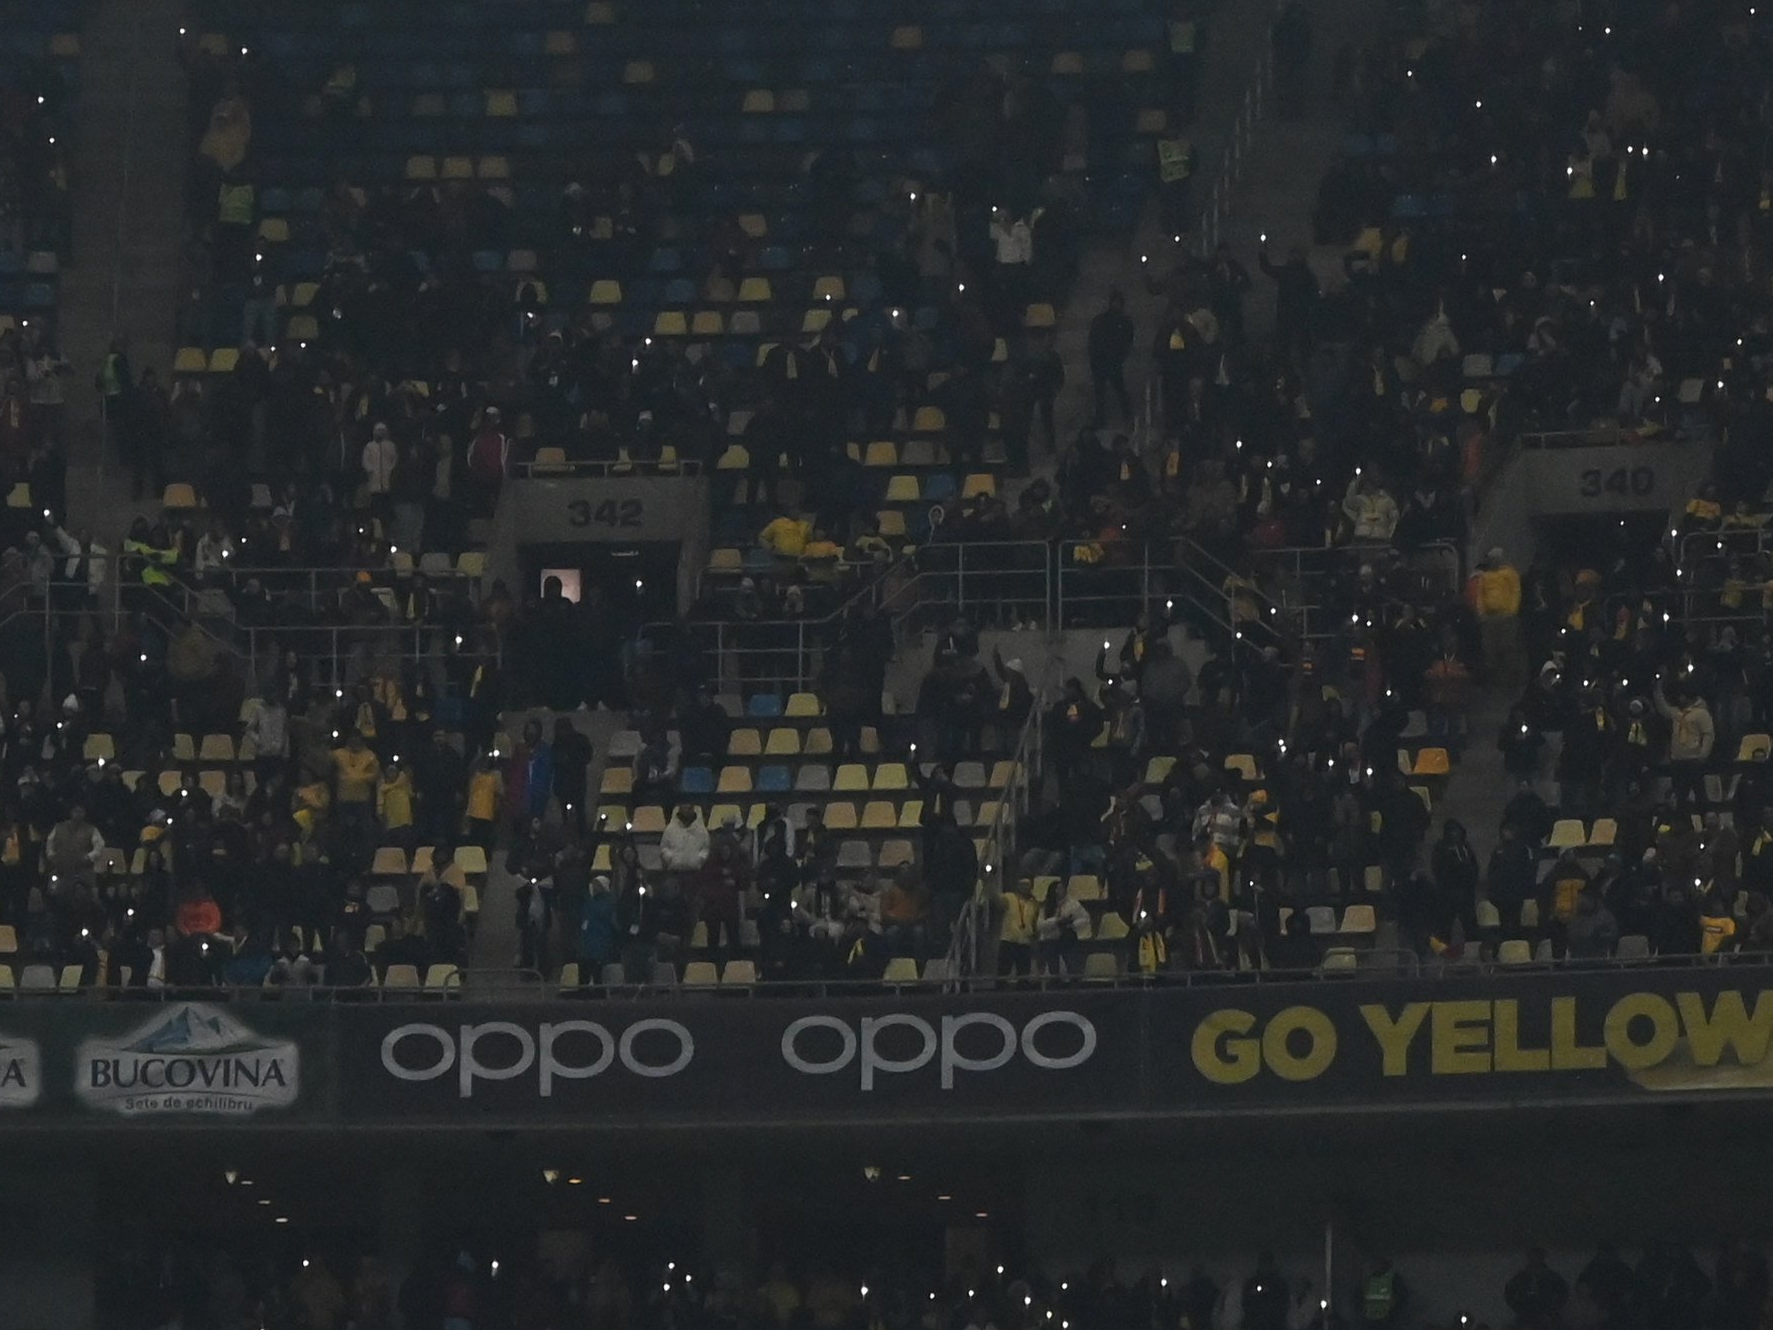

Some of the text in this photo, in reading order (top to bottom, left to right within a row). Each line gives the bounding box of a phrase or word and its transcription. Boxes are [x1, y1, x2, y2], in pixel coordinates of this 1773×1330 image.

[1580, 467, 1655, 497] 340
[568, 499, 644, 528] 342
[381, 1010, 1096, 1098] oppo oppo
[1191, 1006, 1337, 1084] GO
[90, 1059, 286, 1088] BUCOVINA
[163, 1097, 181, 1109] de
[186, 1097, 253, 1111] echilibru
